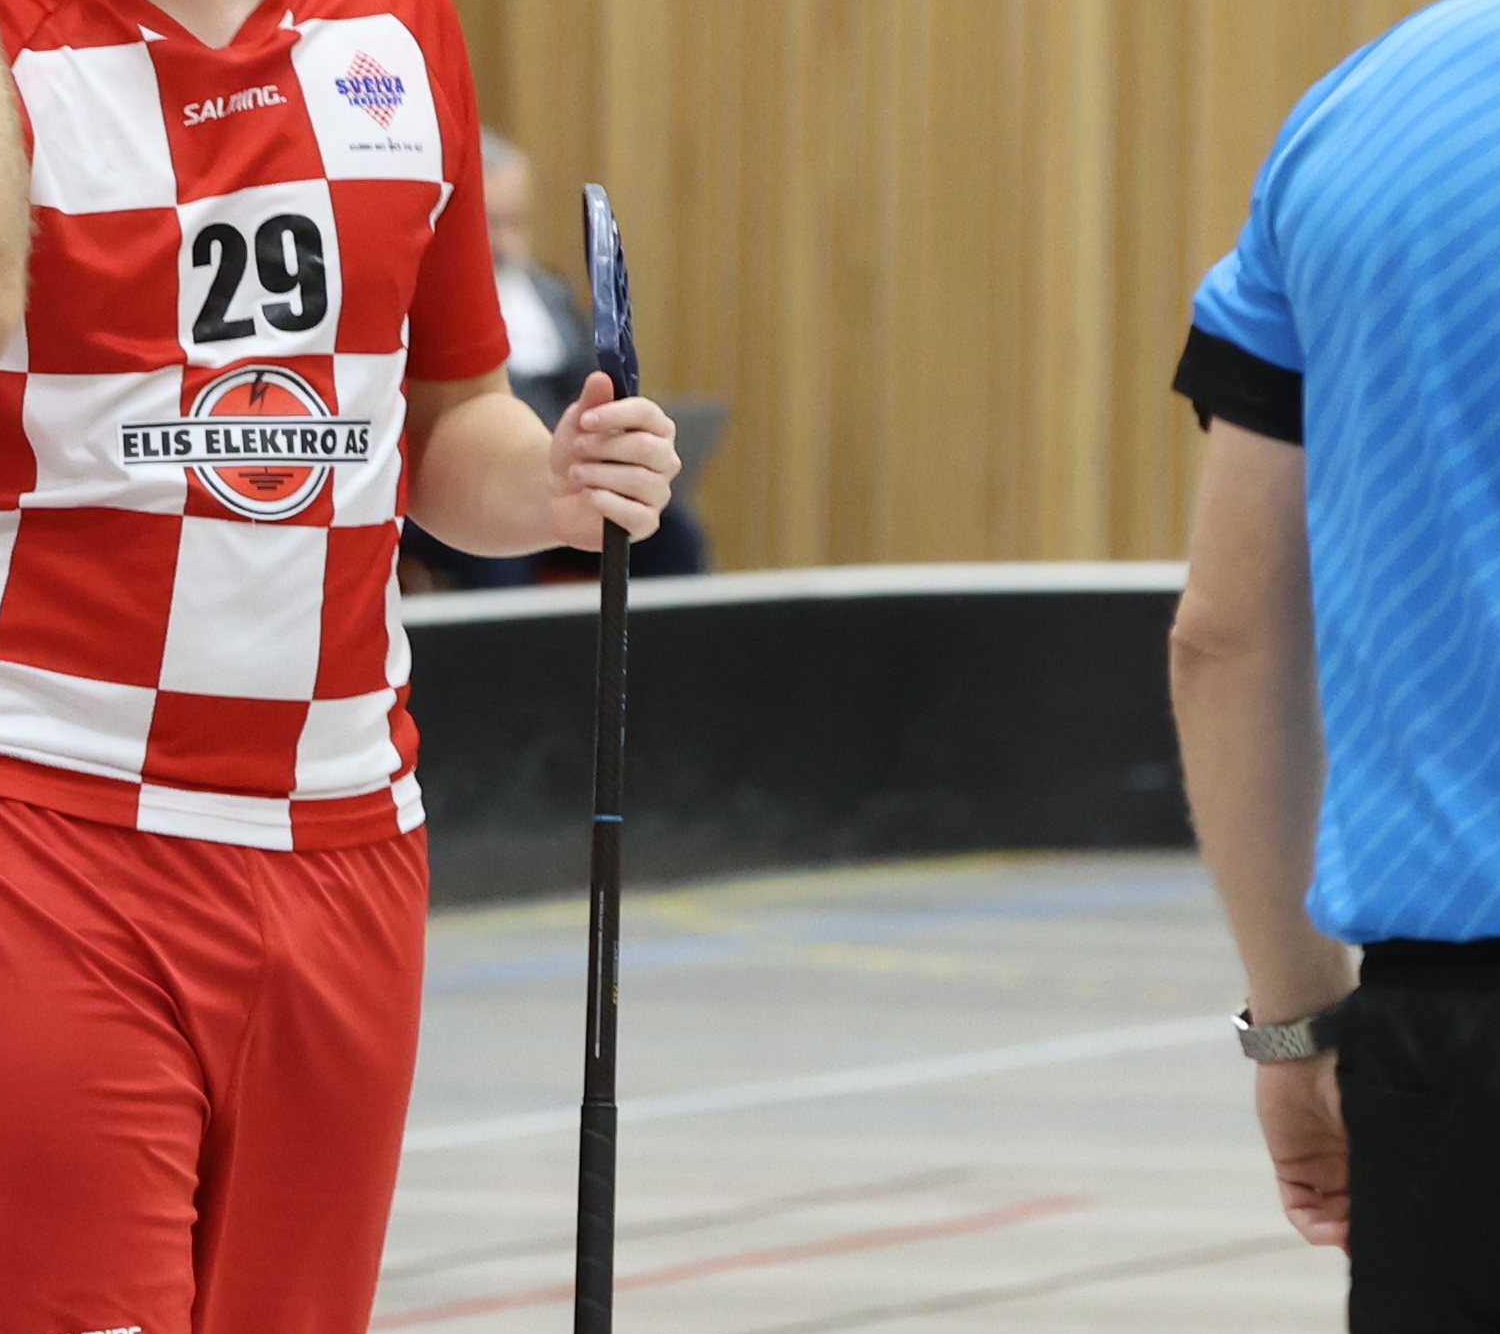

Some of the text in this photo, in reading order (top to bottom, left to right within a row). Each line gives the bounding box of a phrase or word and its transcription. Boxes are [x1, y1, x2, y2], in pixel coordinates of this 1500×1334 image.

[335, 76, 405, 94] SVEIVA
[192, 213, 328, 344] 29
[123, 428, 368, 458] ELIS ELEKTRO AS
